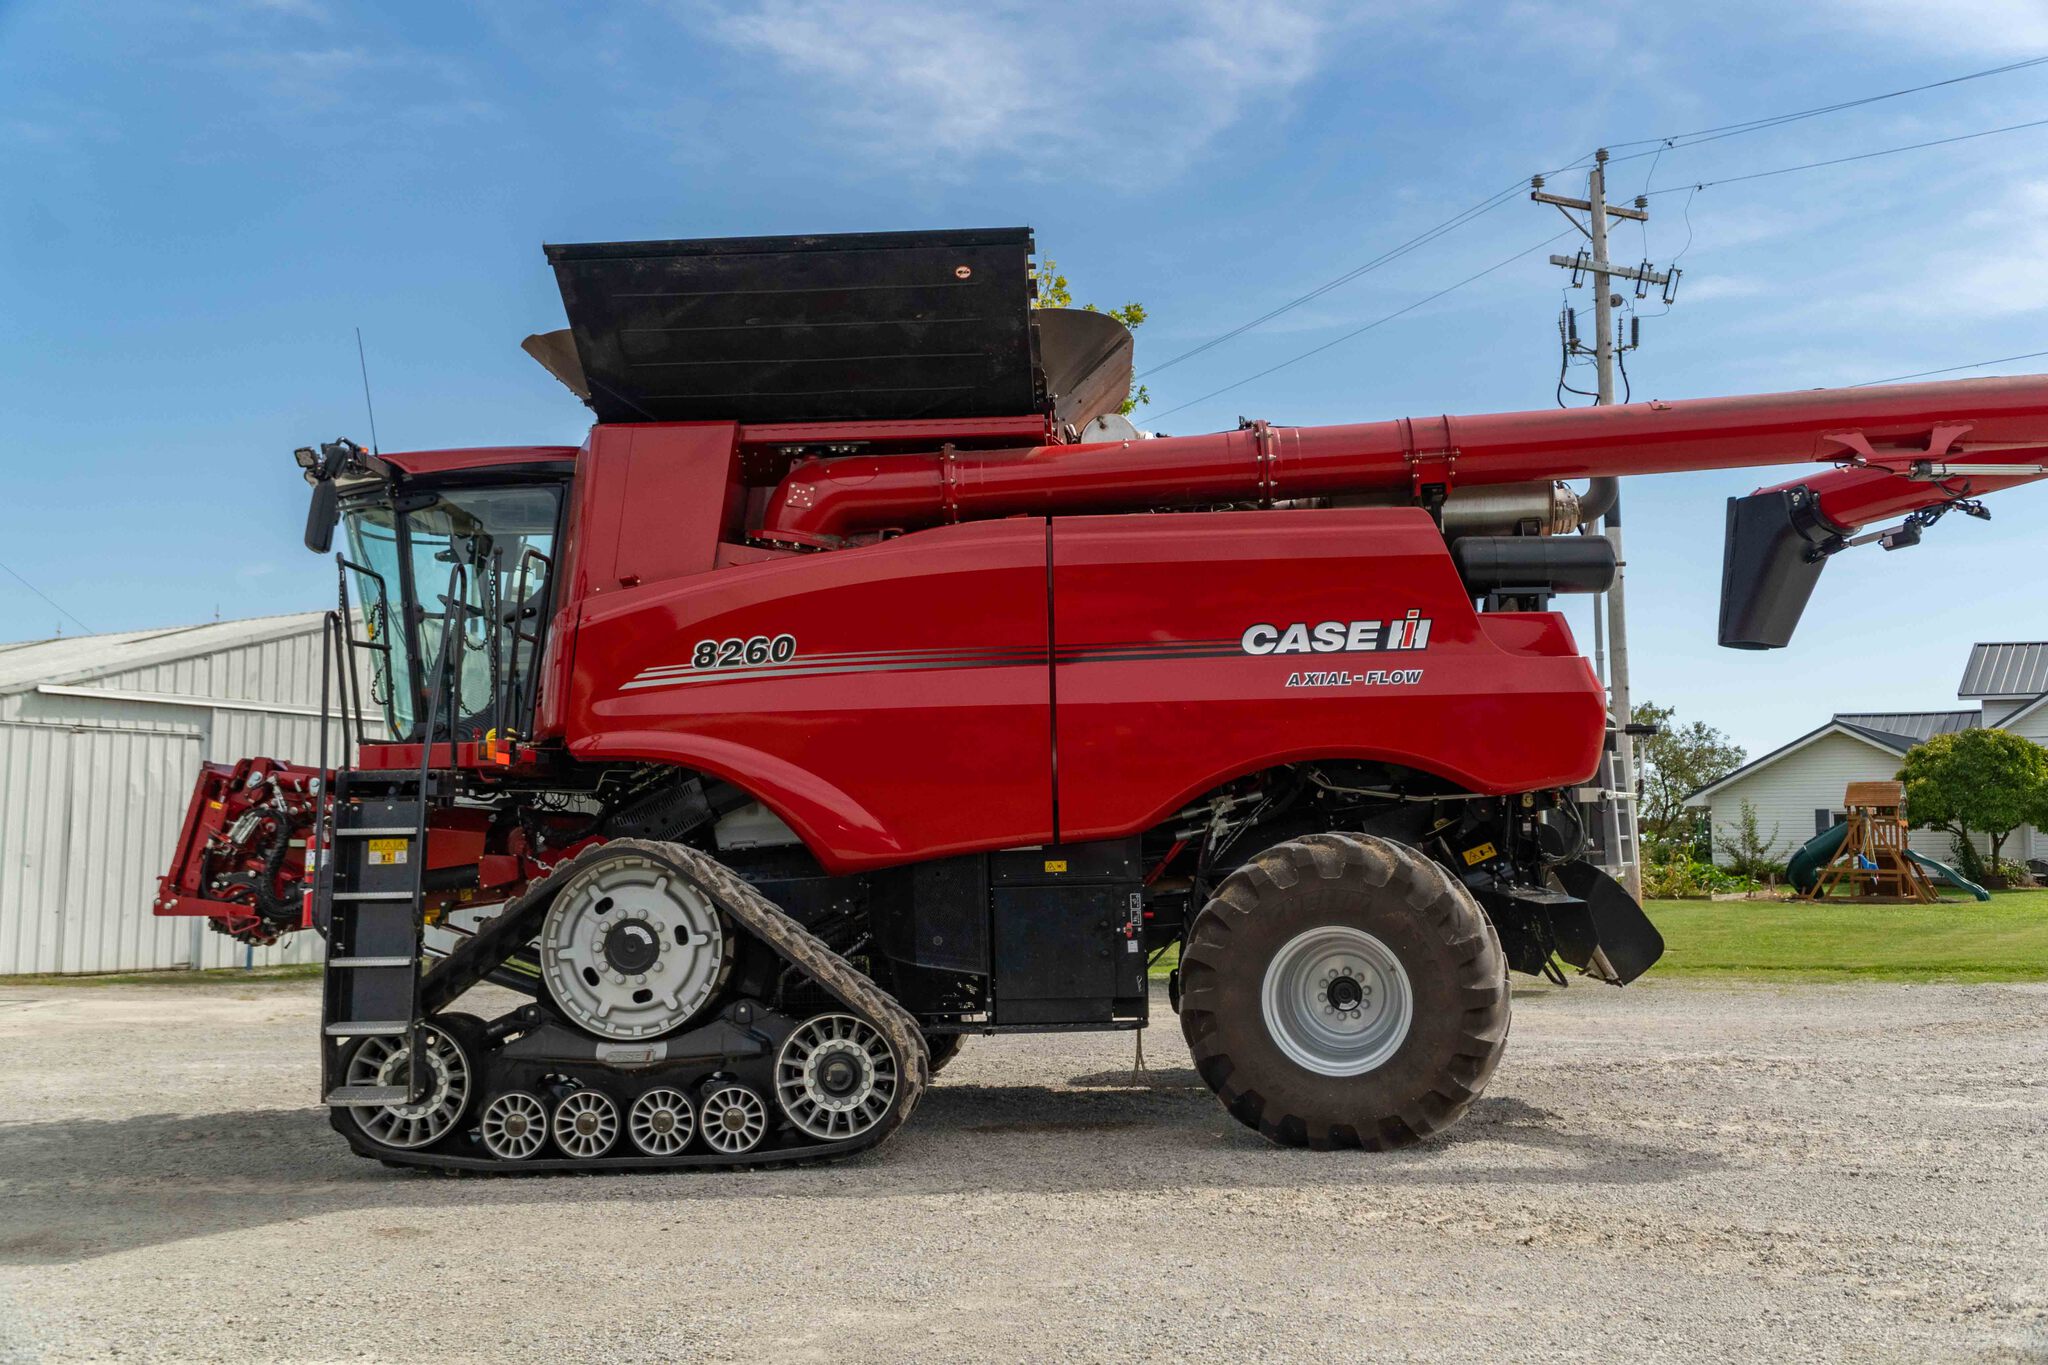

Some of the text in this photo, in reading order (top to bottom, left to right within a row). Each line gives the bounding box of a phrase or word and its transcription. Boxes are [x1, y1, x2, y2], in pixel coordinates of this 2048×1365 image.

[691, 633, 796, 669] 8260
[1241, 621, 1381, 655] CASE
[1286, 669, 1424, 688] AXIAL-FLOW
